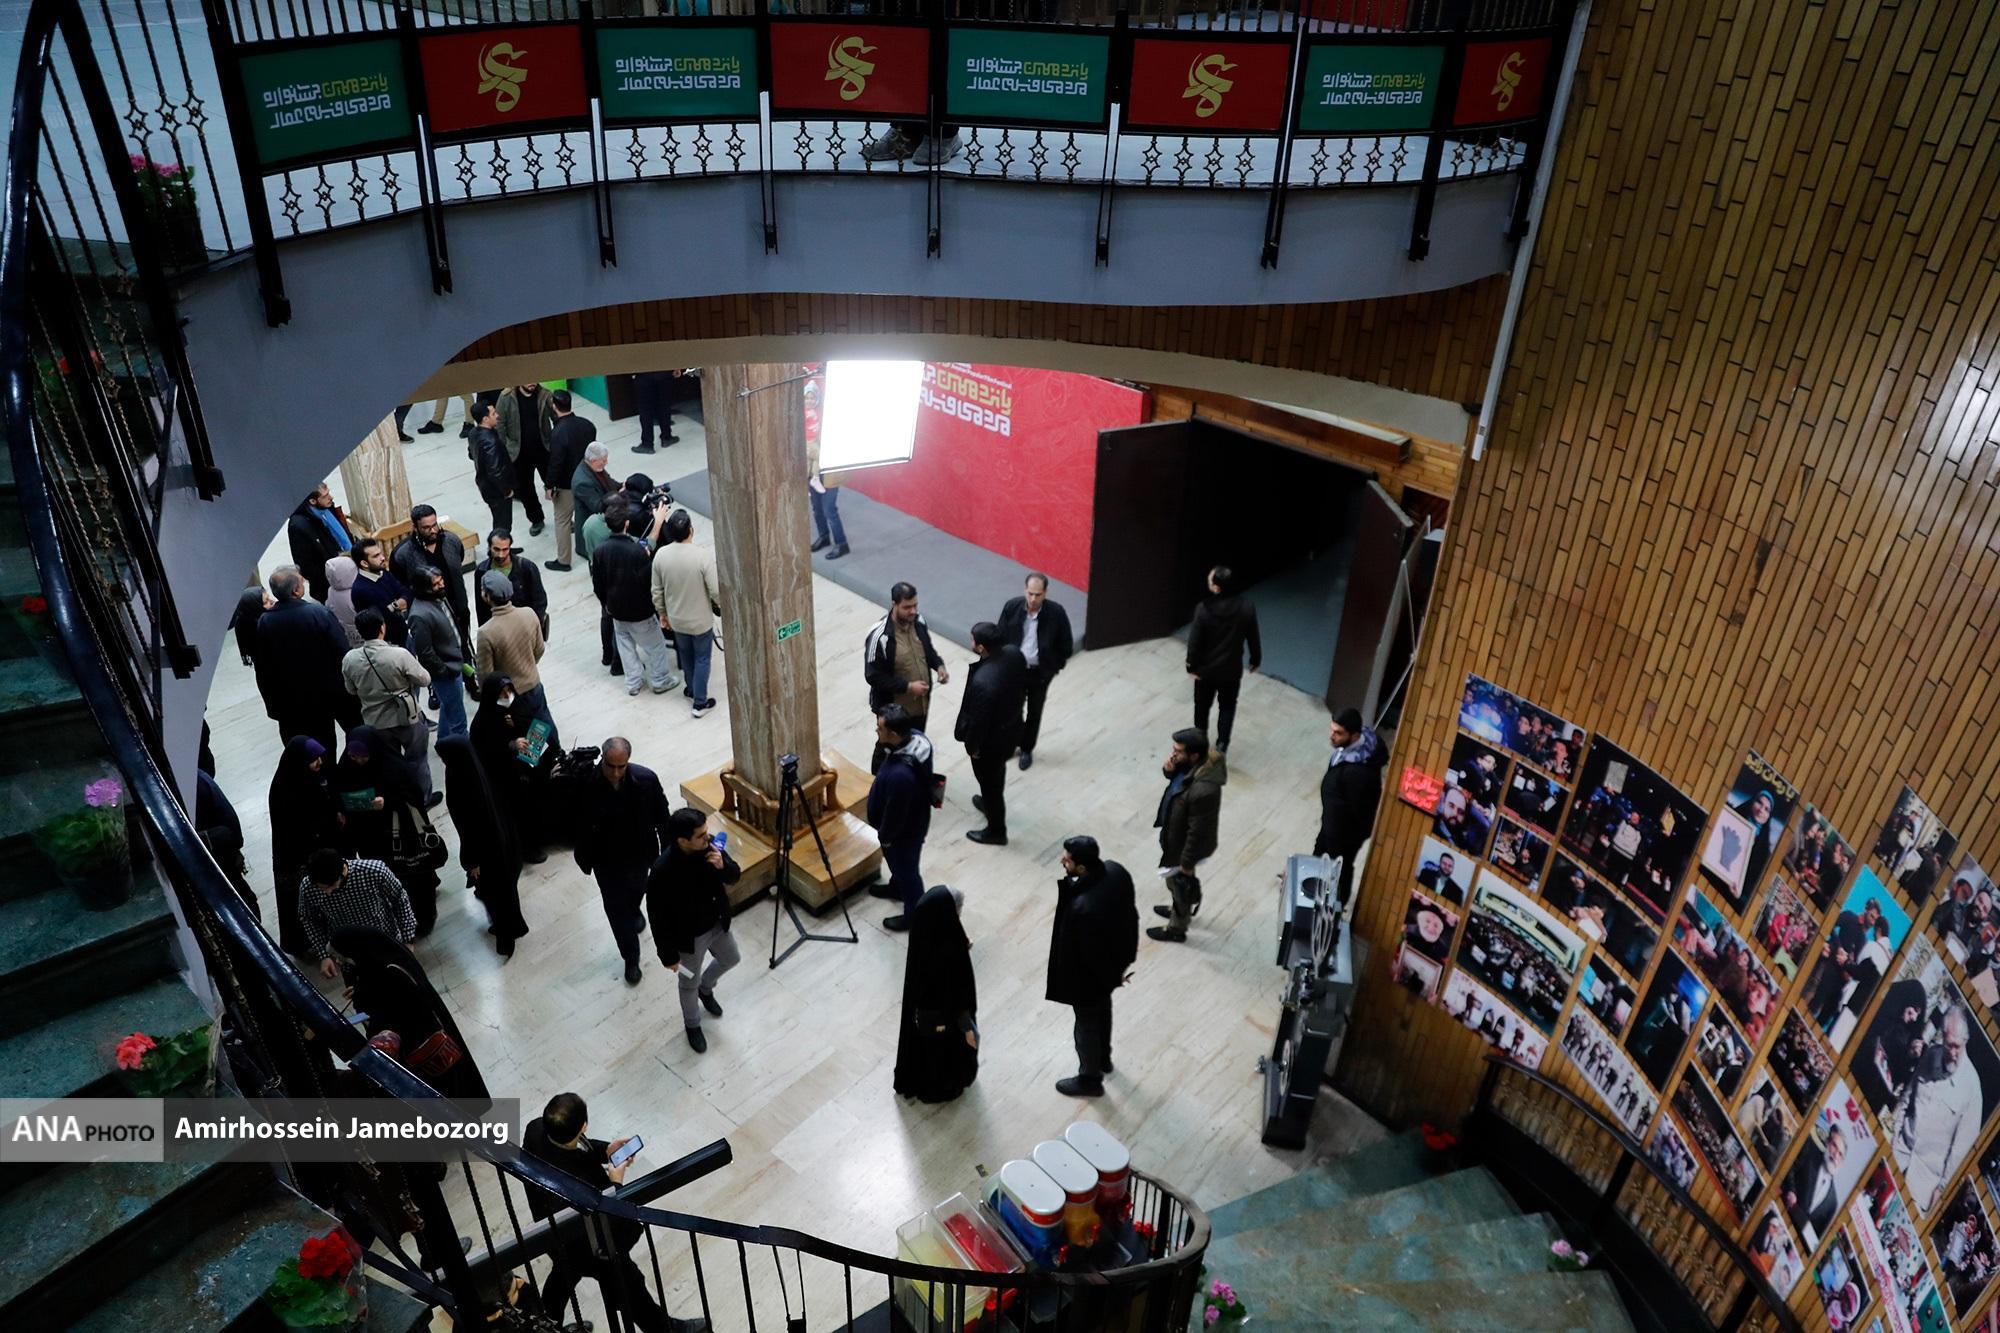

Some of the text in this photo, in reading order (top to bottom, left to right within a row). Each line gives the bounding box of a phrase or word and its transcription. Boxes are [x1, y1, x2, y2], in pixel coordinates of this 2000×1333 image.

[616, 56, 740, 73] پانزدهمین جشنواره
[966, 57, 1089, 80] پانزدهمین جشنواره
[263, 73, 389, 108] پانزدهمین جشنواره
[618, 75, 740, 91] مردمی فیلم عمار
[966, 76, 1088, 95] مردمی فیلم عمار
[1322, 72, 1425, 90] پانزدهمین جشنواره
[1320, 91, 1423, 105] مردمی فیلم عمار
[270, 93, 391, 129] مردمی فیلم عمار
[936, 368, 1012, 416] پانزدهمین
[957, 400, 1011, 437] مردمی
